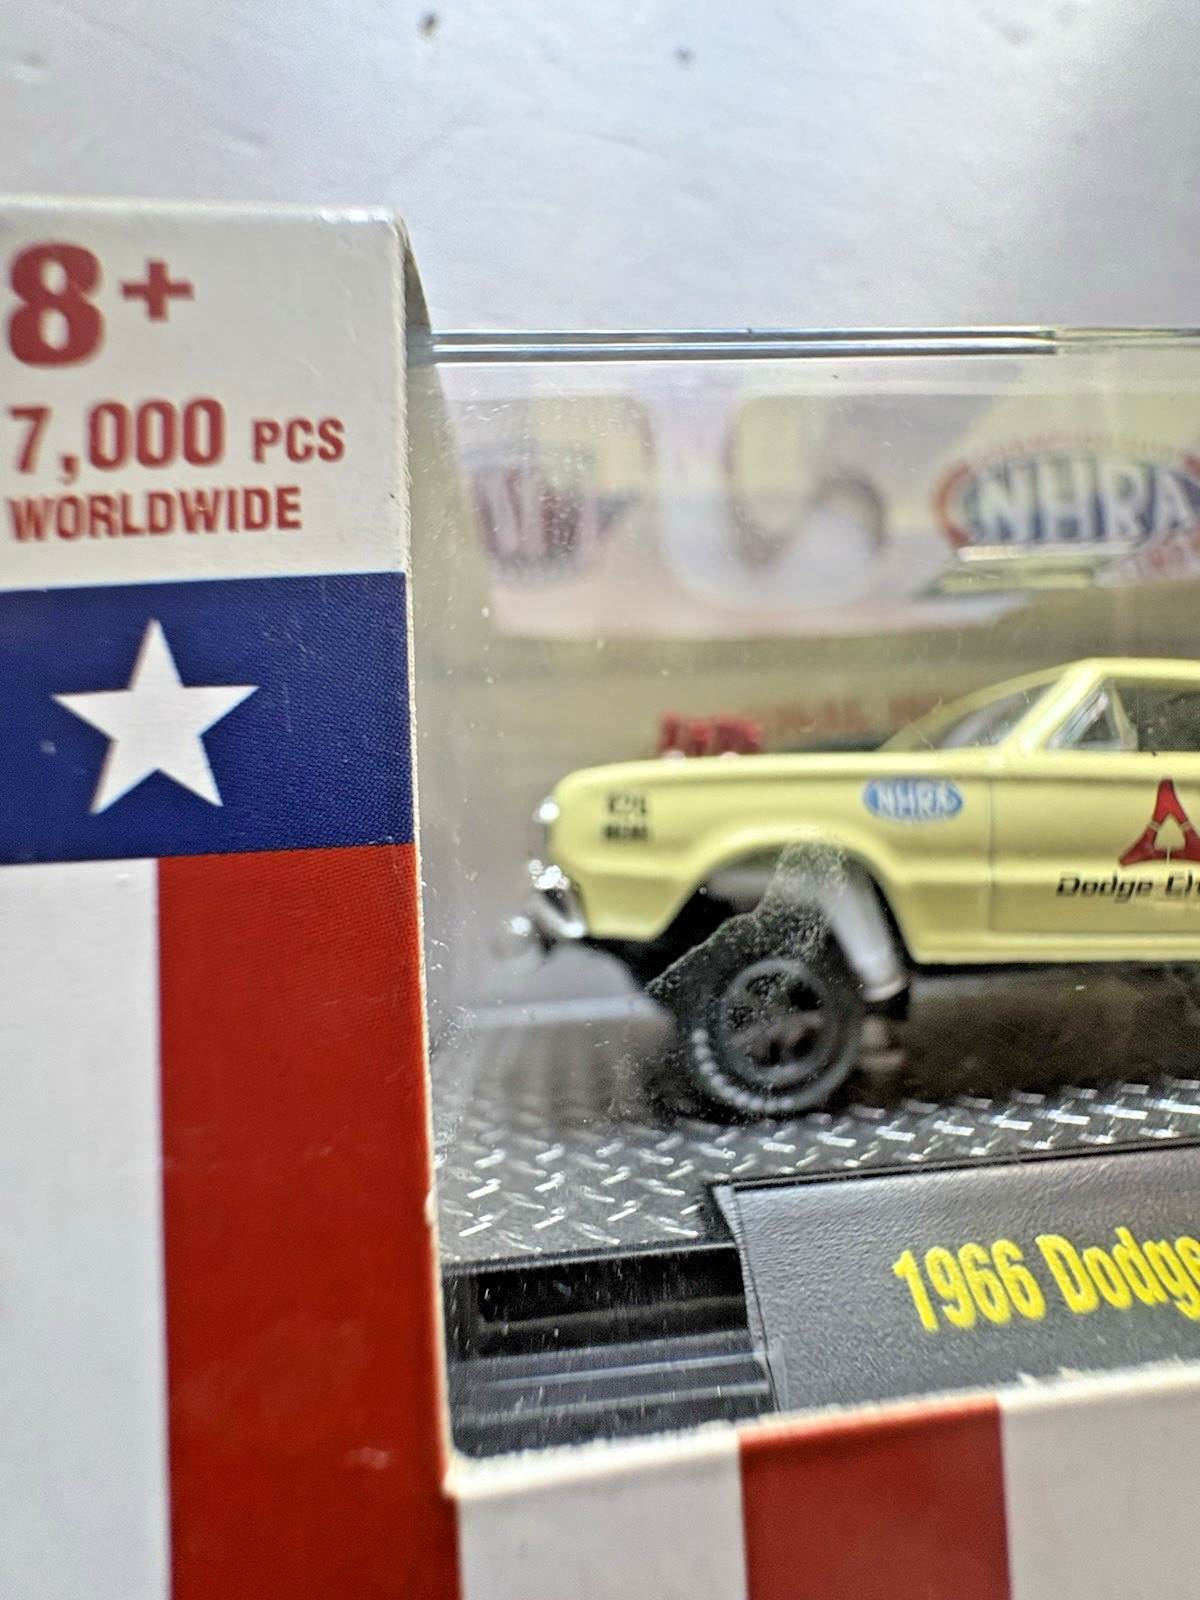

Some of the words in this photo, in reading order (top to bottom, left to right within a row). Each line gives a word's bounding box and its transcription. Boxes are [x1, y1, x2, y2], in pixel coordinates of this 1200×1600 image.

[7, 241, 196, 370] 8+
[8, 396, 226, 484] 7,000
[252, 418, 345, 463] PCS
[8, 486, 303, 542] WORLDWIDE
[979, 458, 1195, 543] NHRA
[877, 780, 955, 818] NHRA
[1057, 874, 1153, 903] Dodge
[892, 1239, 1046, 1331] 1966
